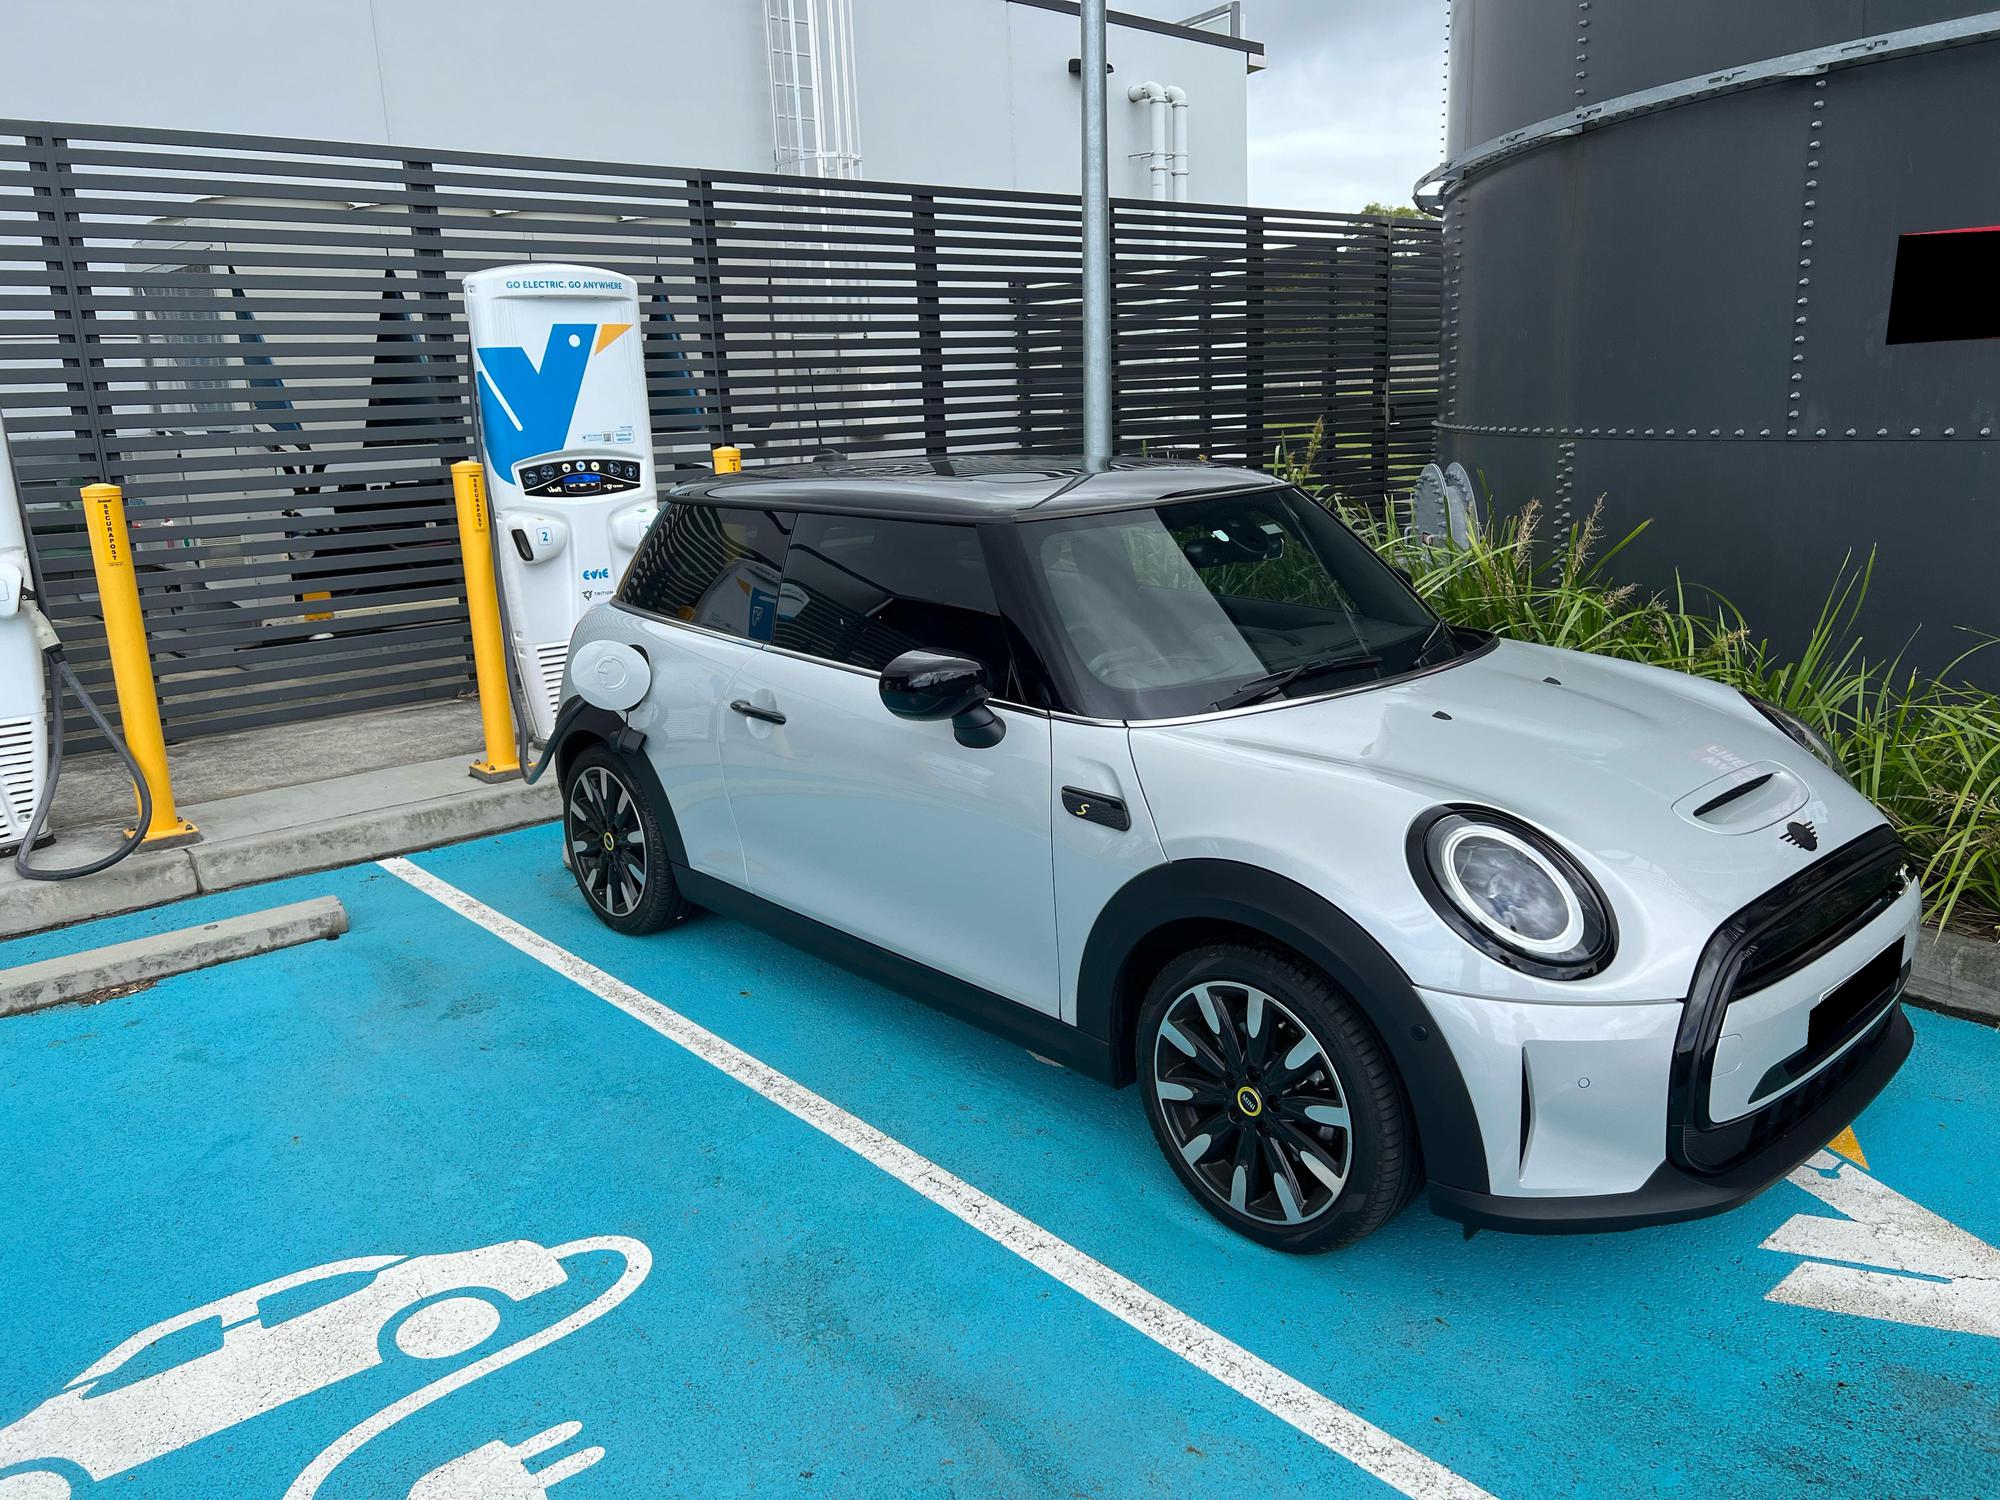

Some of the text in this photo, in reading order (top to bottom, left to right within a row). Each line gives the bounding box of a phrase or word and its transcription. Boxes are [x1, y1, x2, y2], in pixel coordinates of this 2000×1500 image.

[506, 281, 622, 290] GO ELECTRIC. GO ANYWHERE
[473, 478, 482, 527] SECURAPOST
[103, 503, 117, 560] SECURAPOST
[541, 531, 549, 541] 2
[1075, 804, 1090, 816] S
